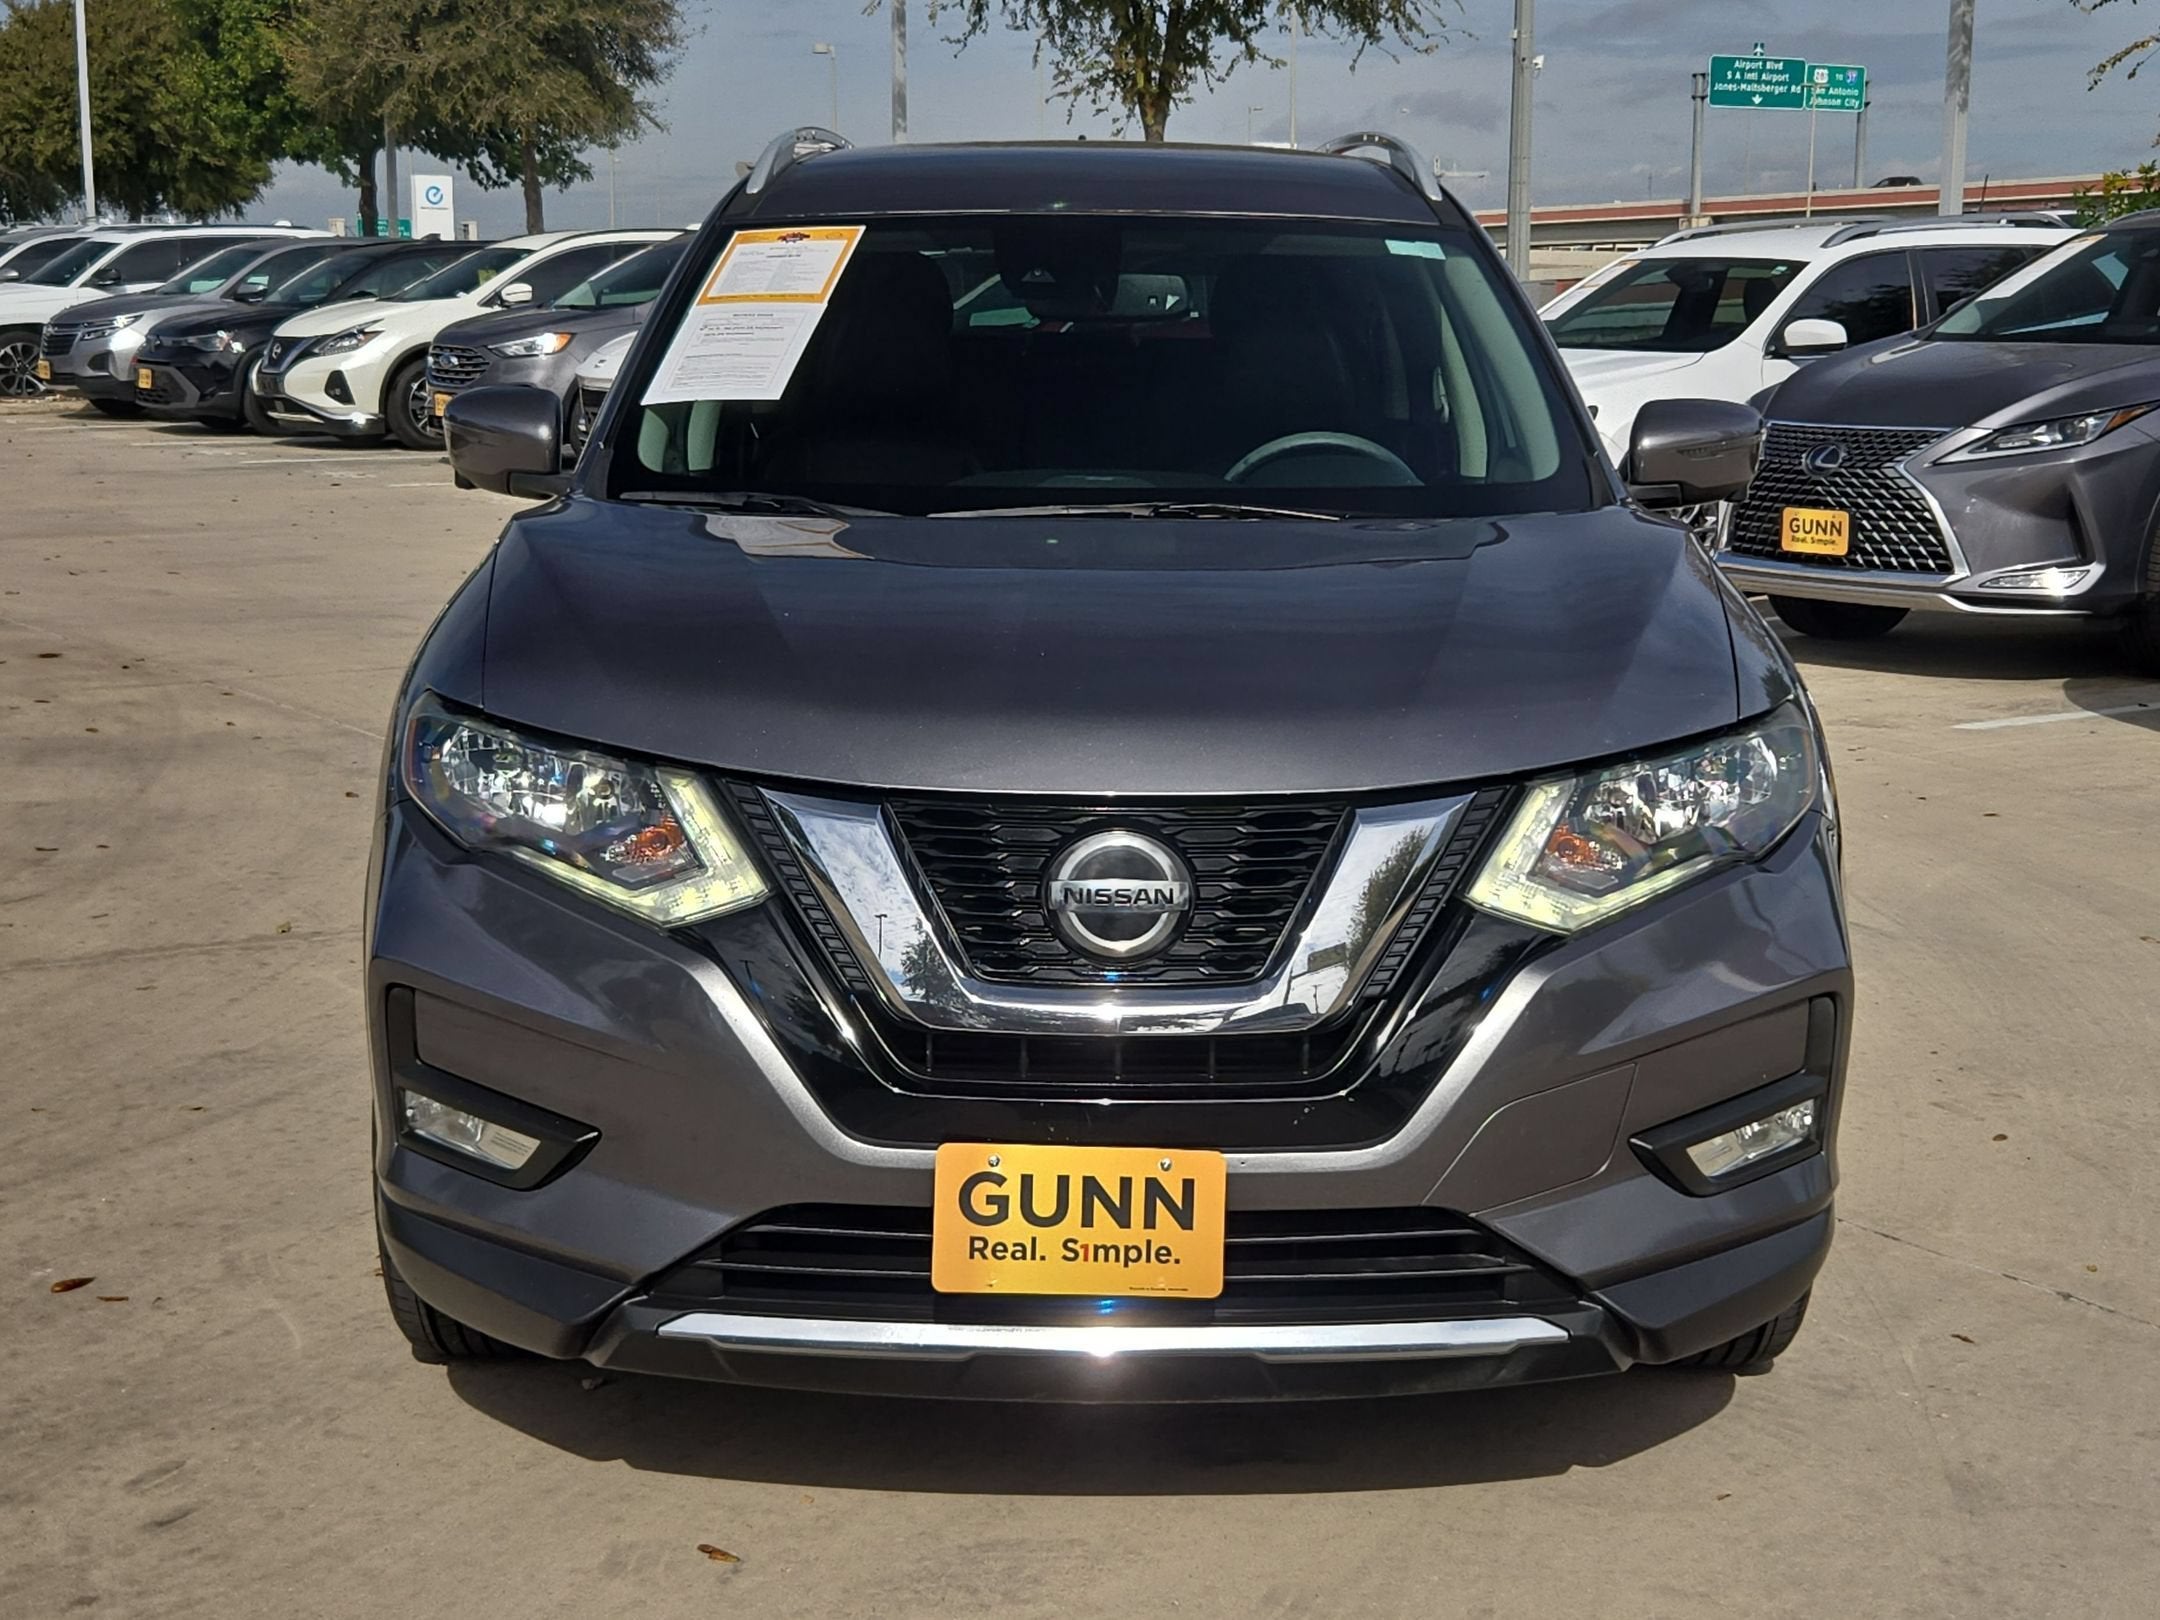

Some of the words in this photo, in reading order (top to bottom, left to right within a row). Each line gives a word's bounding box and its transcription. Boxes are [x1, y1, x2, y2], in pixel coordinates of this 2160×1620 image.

[1734, 60, 1762, 71] Airport
[1766, 61, 1784, 71] Blvd
[1727, 71, 1732, 79] S
[1735, 71, 1741, 79] A
[1761, 72, 1790, 83] Airport
[1714, 82, 1788, 95] Jones-Maltsberger
[1791, 84, 1801, 94] Rd
[1828, 87, 1859, 96] Antonio
[1844, 98, 1860, 109] City
[1789, 517, 1842, 537] GUNN
[1063, 887, 1174, 905] NISSAN
[958, 1171, 1195, 1231] GUNN
[968, 1236, 1046, 1261] Real.
